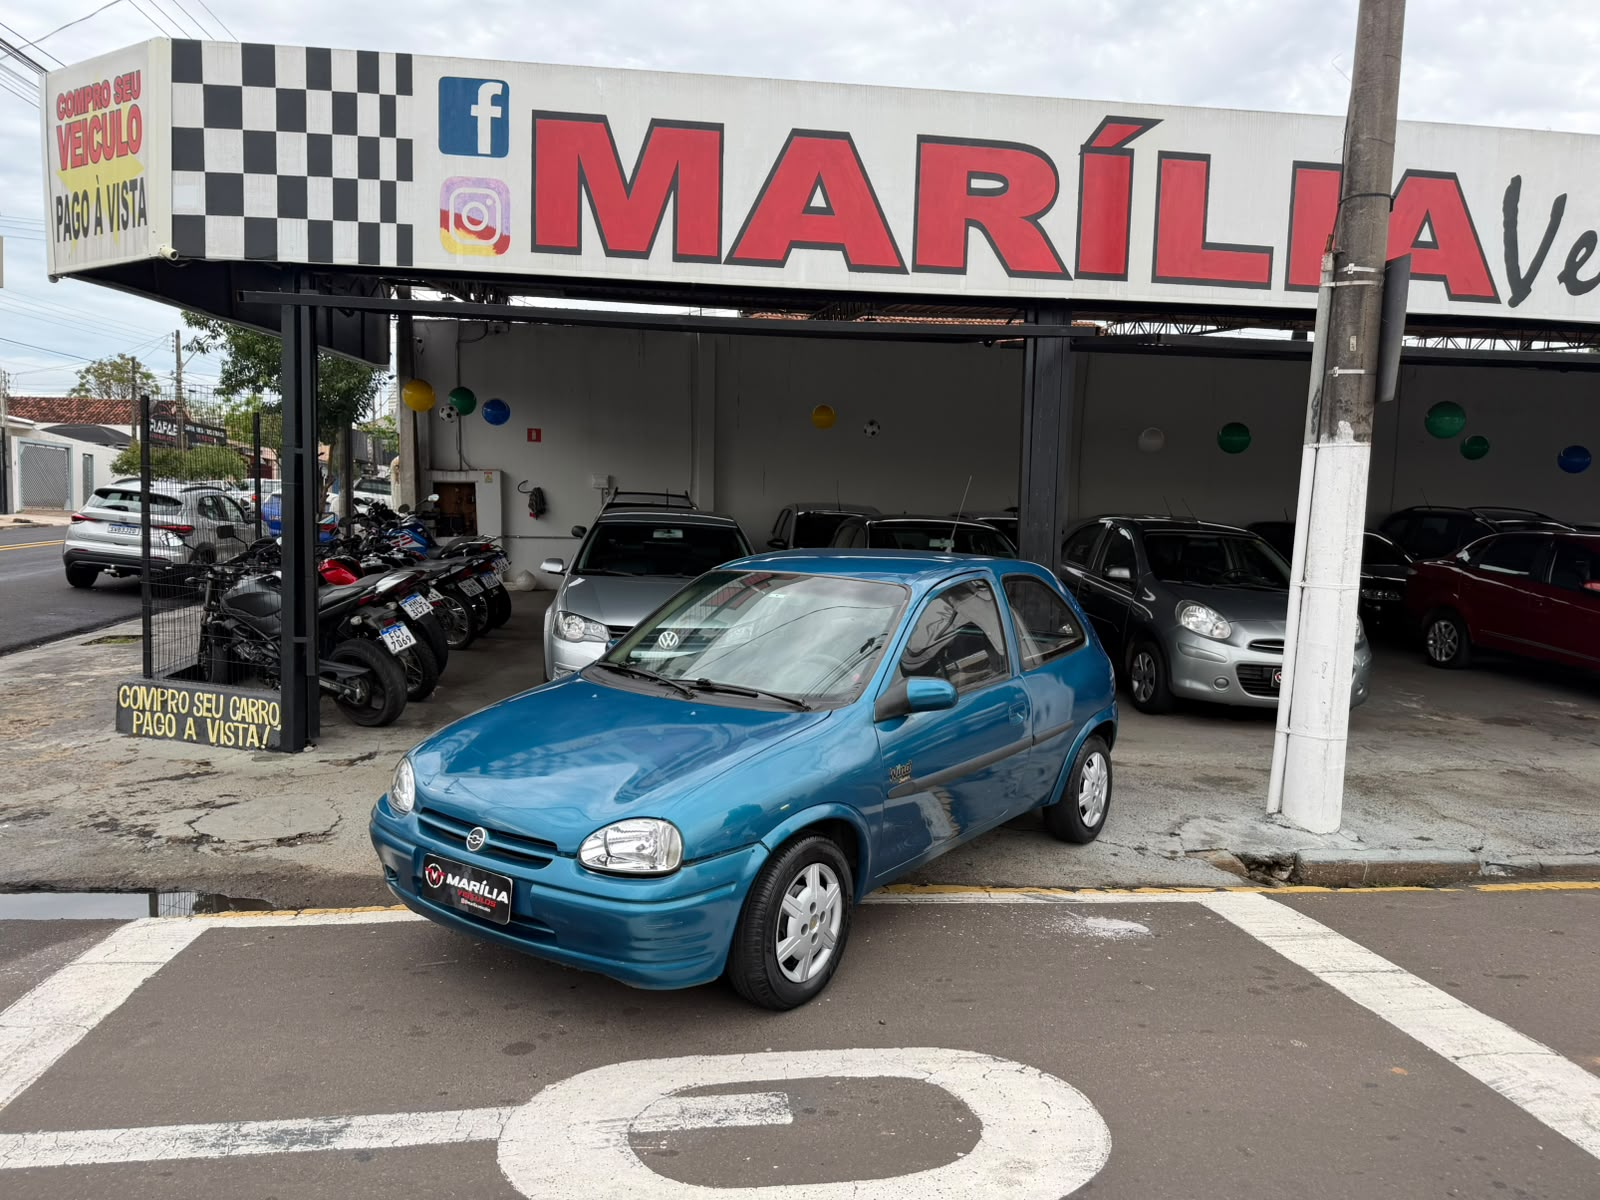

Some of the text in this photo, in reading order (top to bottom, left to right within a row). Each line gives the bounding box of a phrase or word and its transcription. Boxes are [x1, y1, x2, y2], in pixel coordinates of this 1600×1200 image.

[56, 70, 141, 121] COMPRO SEU
[56, 174, 148, 243] PAGO À VISTA
[531, 109, 1502, 305] MARÍLIA
[149, 418, 178, 436] RAFAE
[119, 685, 190, 714] COMPRO
[193, 692, 224, 718] SEU
[132, 711, 271, 749] PAGO A VISTA!
[446, 873, 509, 904] MARÍLIA
